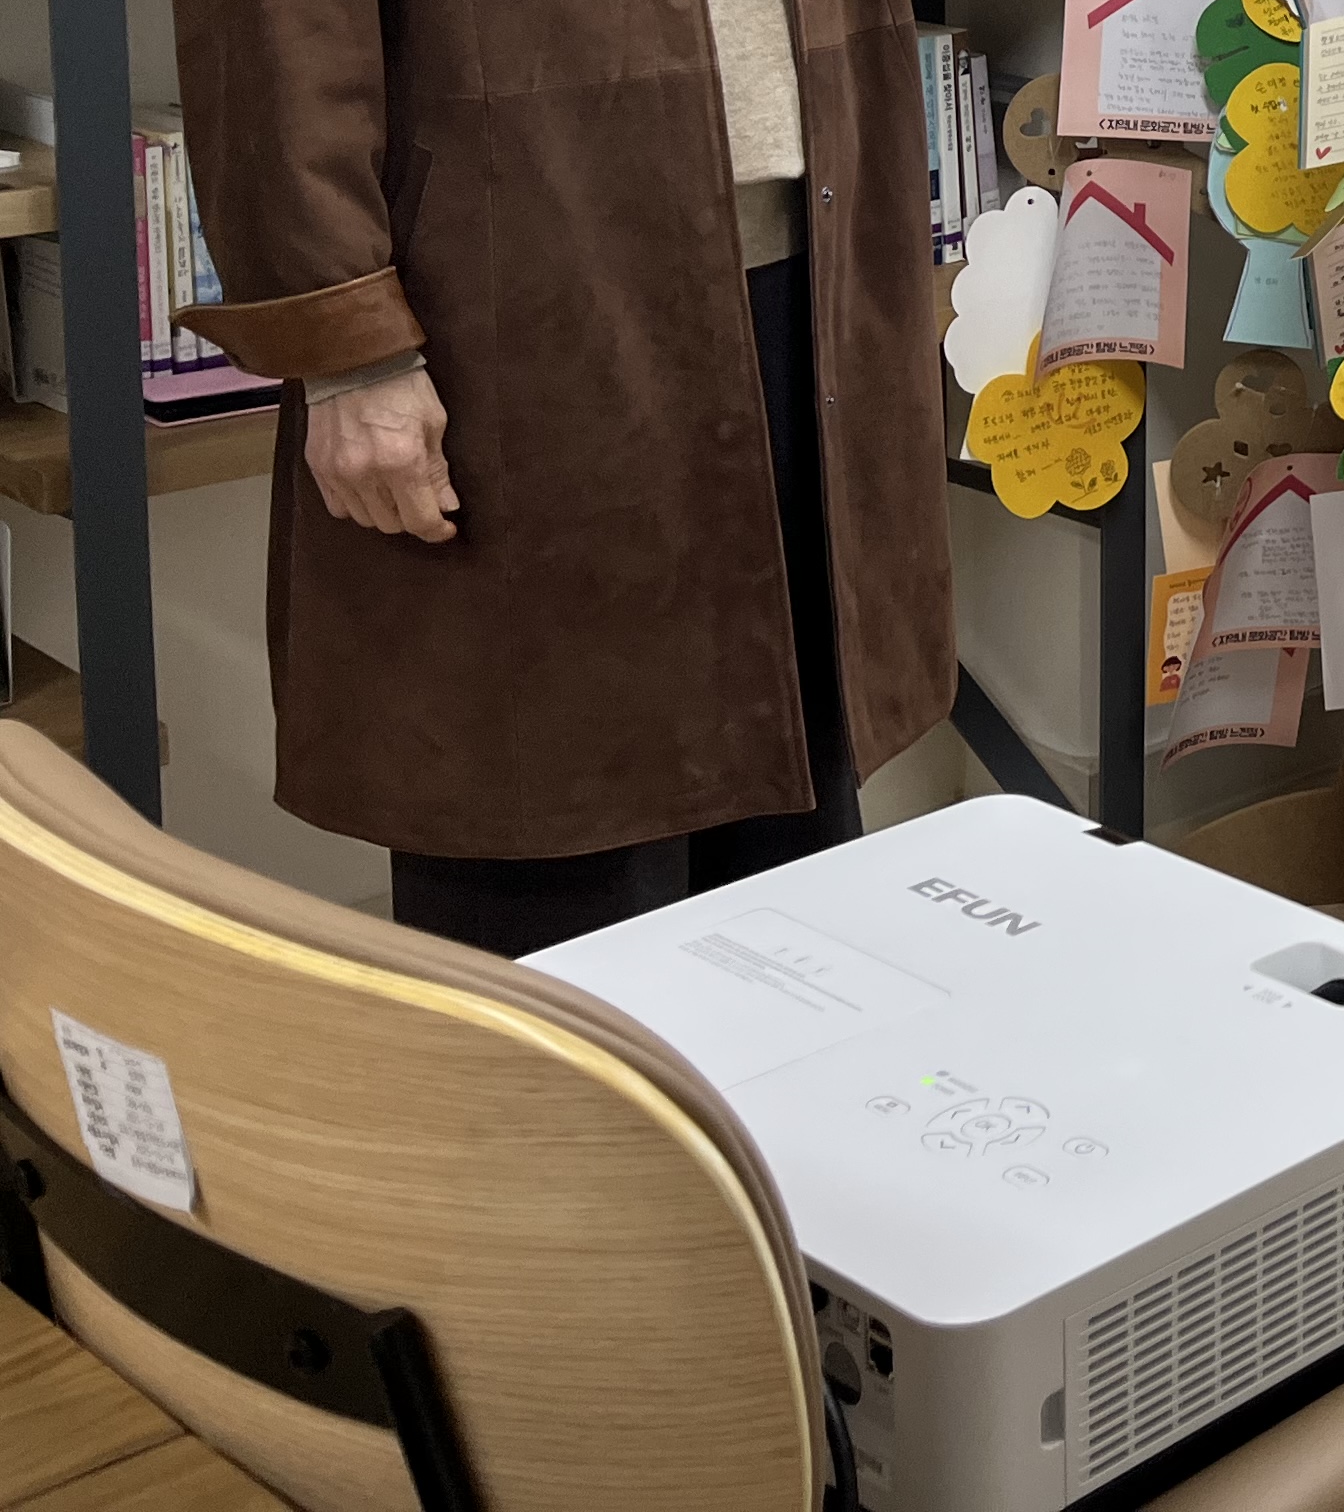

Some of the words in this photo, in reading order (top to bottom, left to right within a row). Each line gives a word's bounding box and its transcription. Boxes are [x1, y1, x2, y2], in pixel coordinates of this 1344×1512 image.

[1139, 119, 1180, 135] 문화공간
[1181, 120, 1204, 135] 탐방
[1060, 343, 1095, 360] 문화공간
[1096, 342, 1117, 353] 탐방
[1248, 631, 1286, 643] 문화공간
[1288, 630, 1308, 641] 탐방
[907, 877, 1042, 937] EFUN
